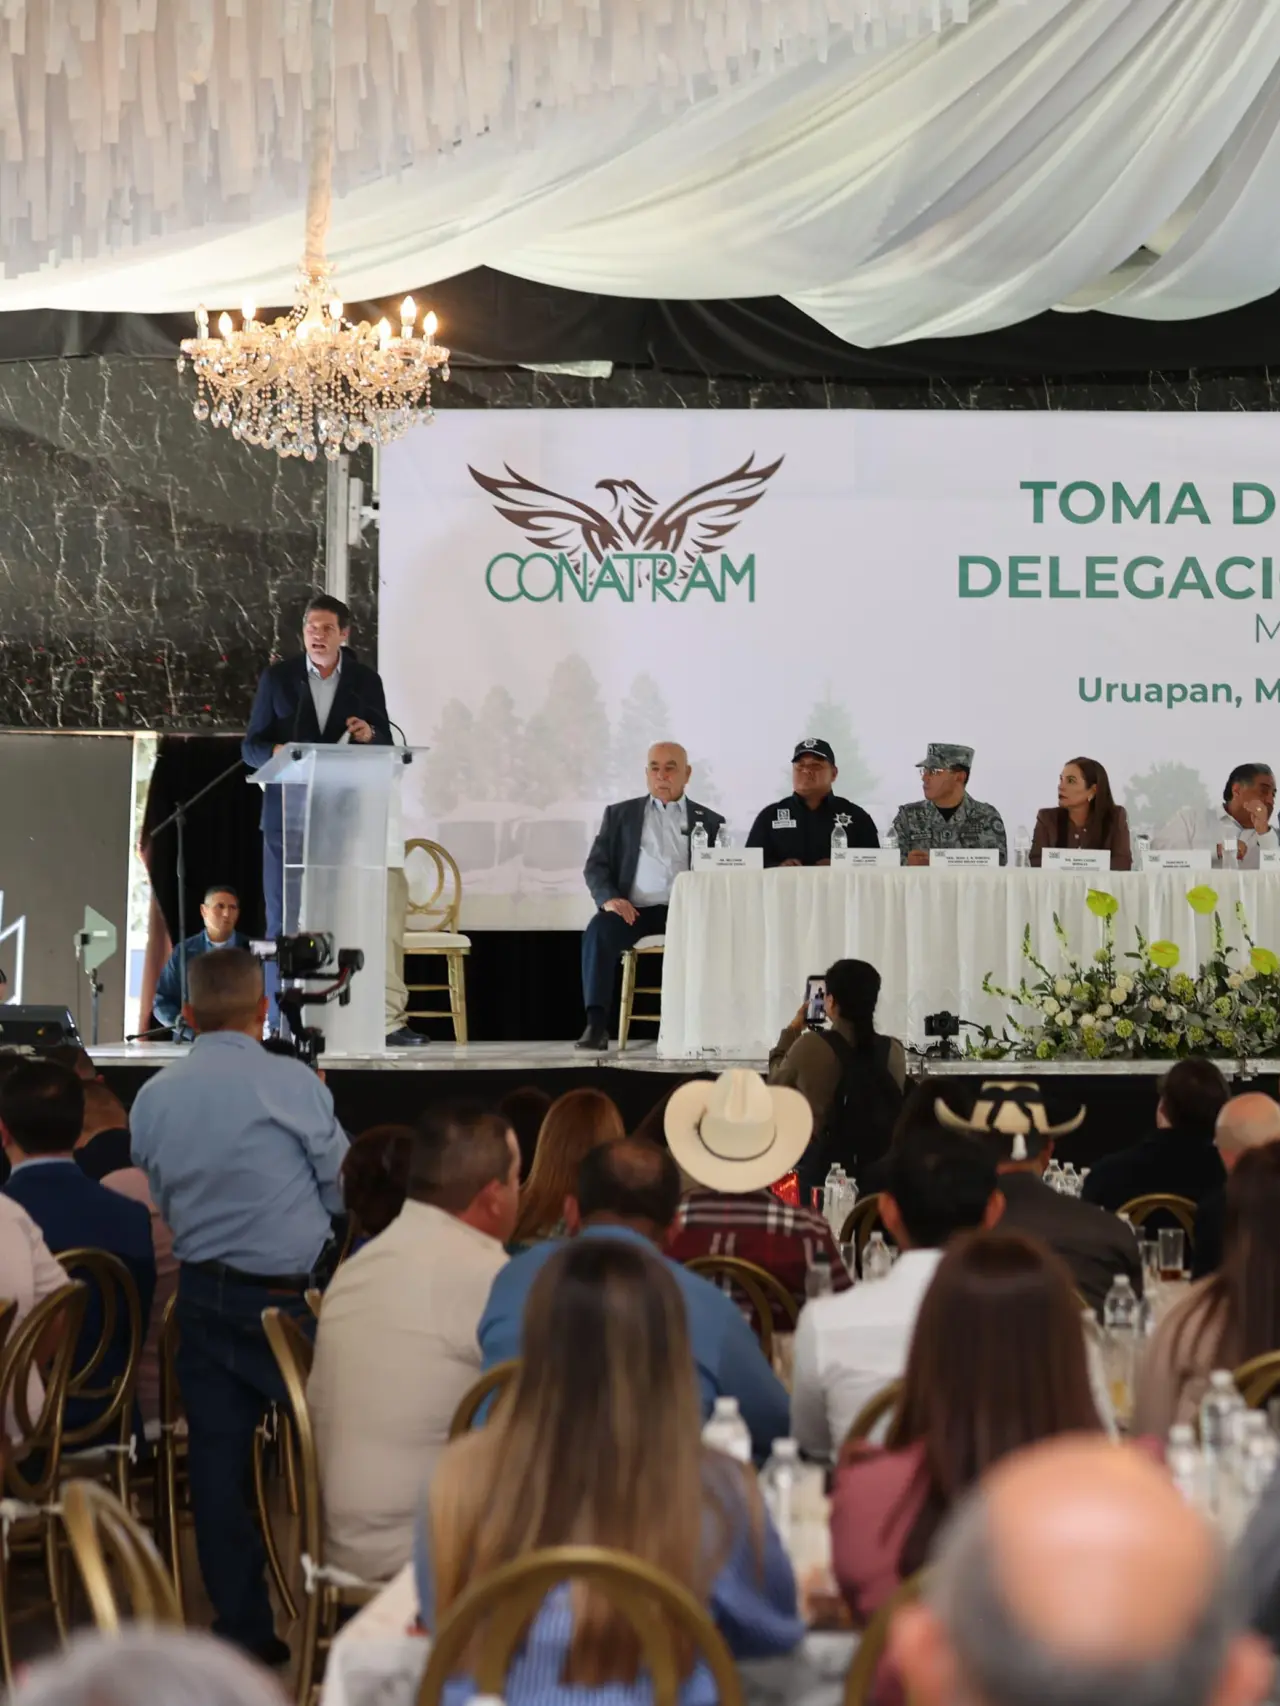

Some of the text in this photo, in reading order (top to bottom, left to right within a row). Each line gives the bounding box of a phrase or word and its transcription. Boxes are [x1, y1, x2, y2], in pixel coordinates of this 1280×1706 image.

[1020, 480, 1210, 526] TOMA
[485, 551, 757, 604] CONATRAM
[1078, 677, 1242, 709] Uruapan,
